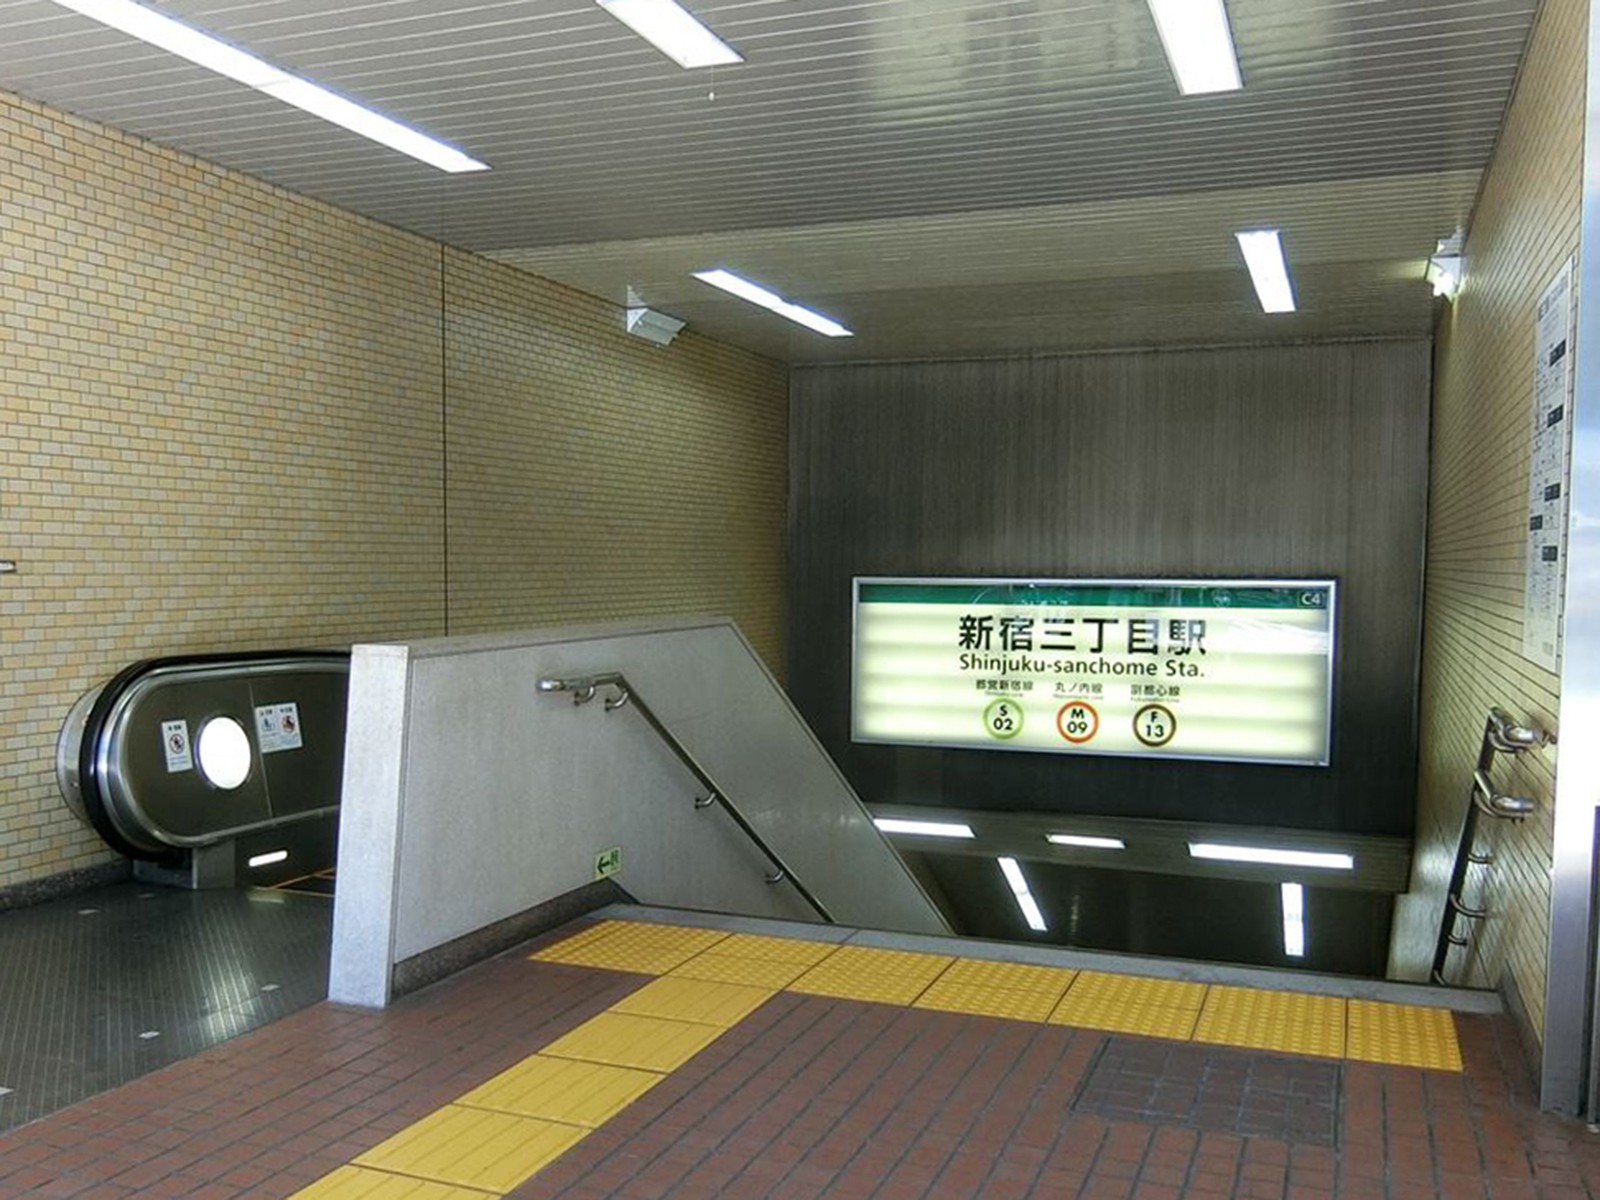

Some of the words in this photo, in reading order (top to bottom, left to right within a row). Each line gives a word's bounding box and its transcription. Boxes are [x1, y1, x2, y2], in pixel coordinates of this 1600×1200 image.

[1301, 593, 1321, 605] C4
[958, 614, 1206, 655] 新宿三丁目駅
[959, 653, 1158, 677] Shinjuku-sanchome
[1165, 659, 1205, 677] Sta.
[999, 704, 1008, 717] S
[1071, 708, 1085, 719] M
[1150, 711, 1159, 723] F
[993, 717, 1013, 730] 02
[1067, 721, 1089, 734] 09
[1146, 724, 1165, 738] 13
